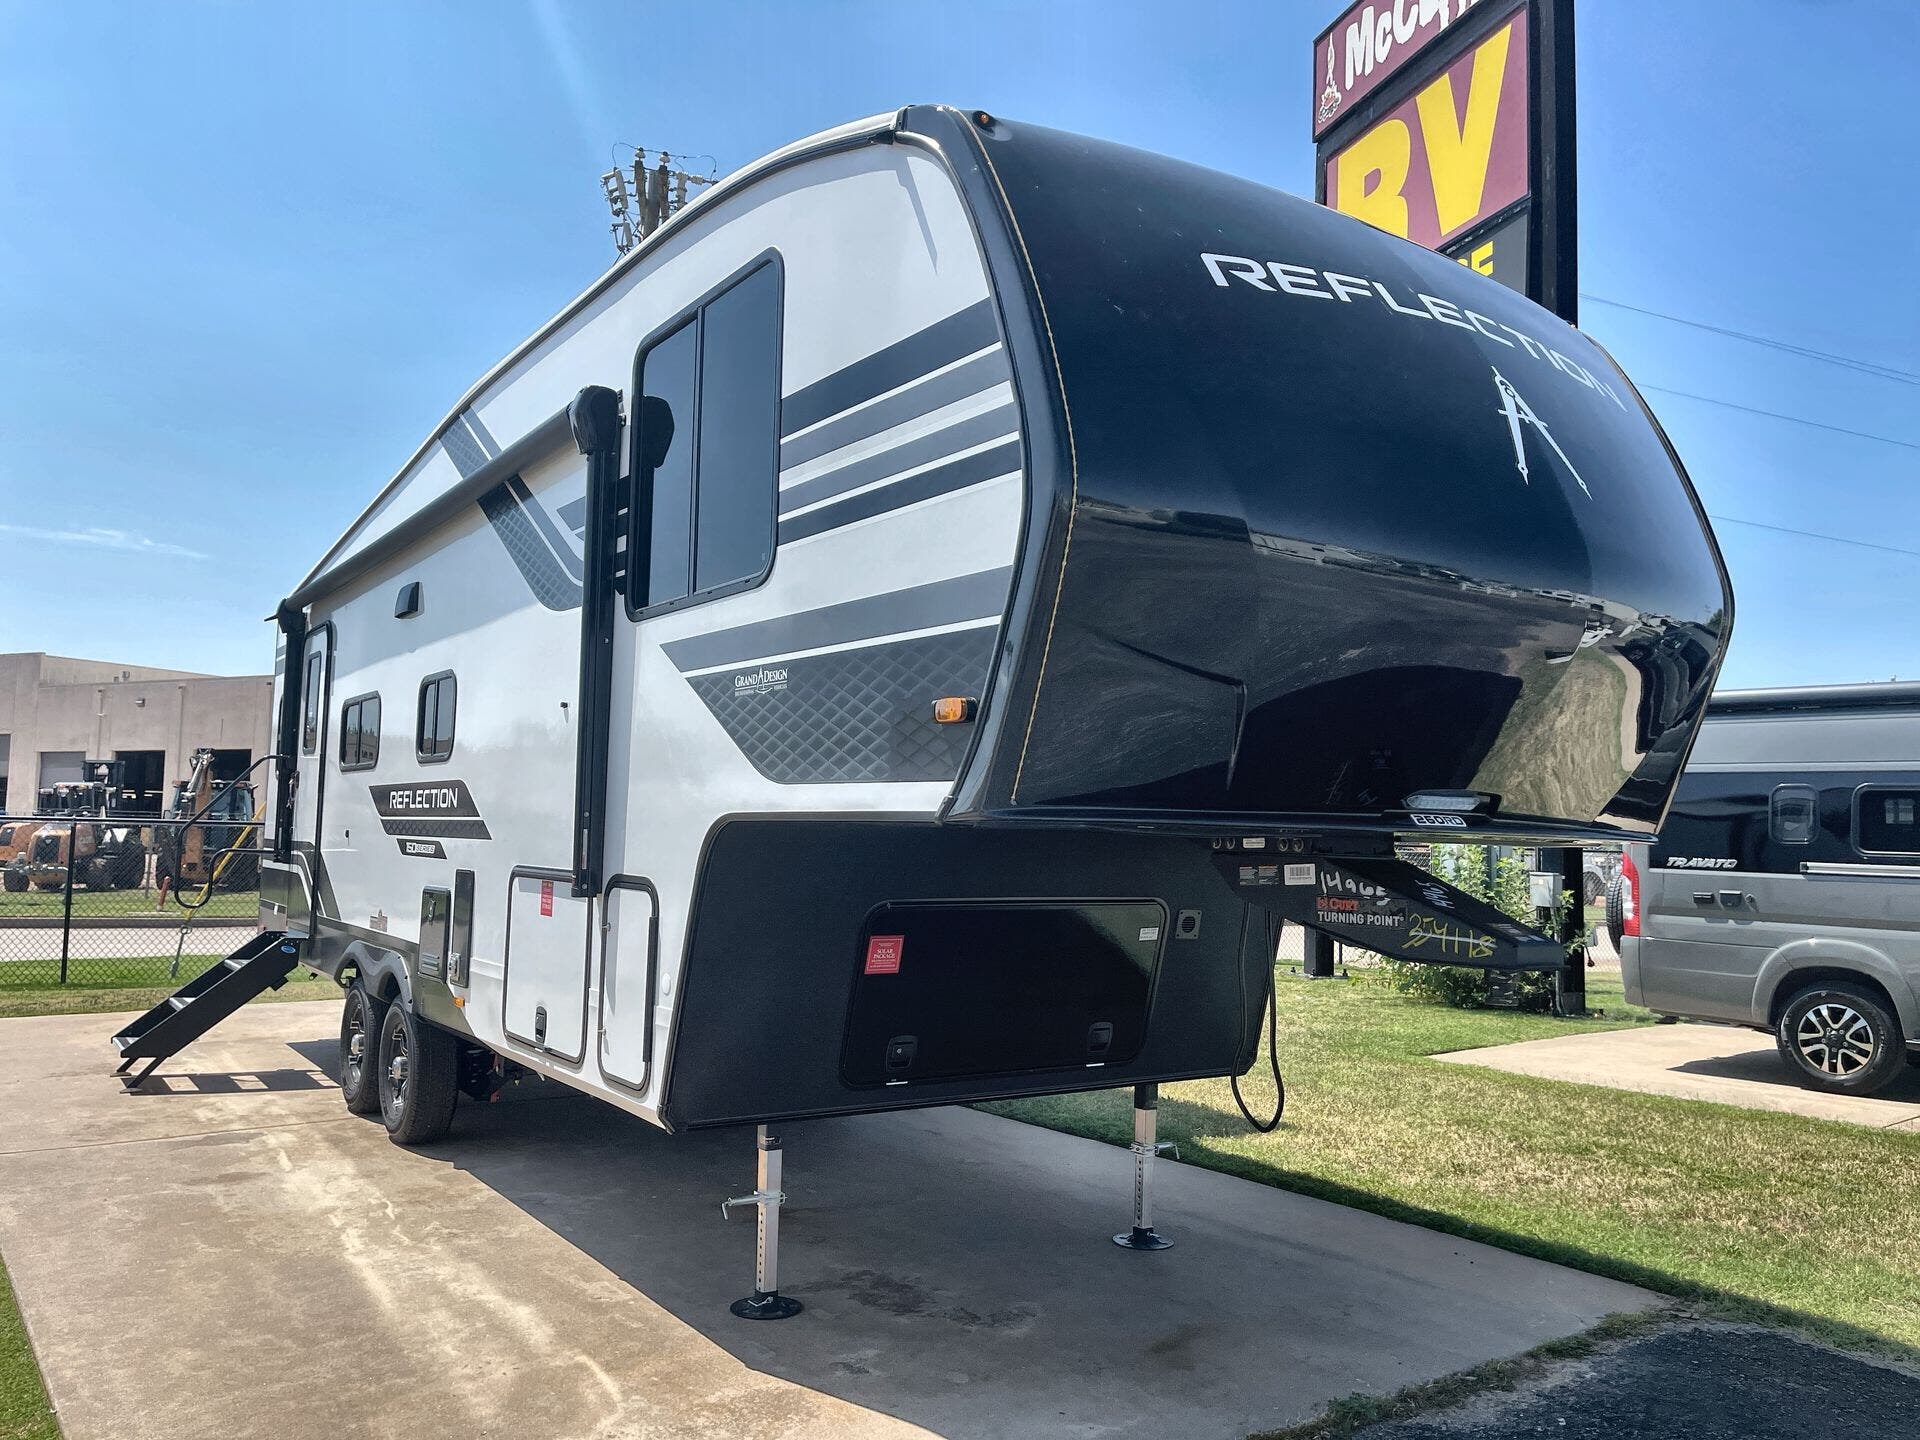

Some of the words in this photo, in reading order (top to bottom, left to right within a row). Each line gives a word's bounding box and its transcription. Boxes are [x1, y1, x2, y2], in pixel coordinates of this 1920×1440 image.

[1337, 23, 1512, 239] RV
[1200, 252, 1628, 412] REFLECTION
[735, 674, 757, 688] GRAND
[764, 668, 788, 683] DESIGN
[389, 787, 459, 809] REFLECTION
[1666, 856, 1738, 868] TRAVATO
[1317, 911, 1365, 925] TURNING
